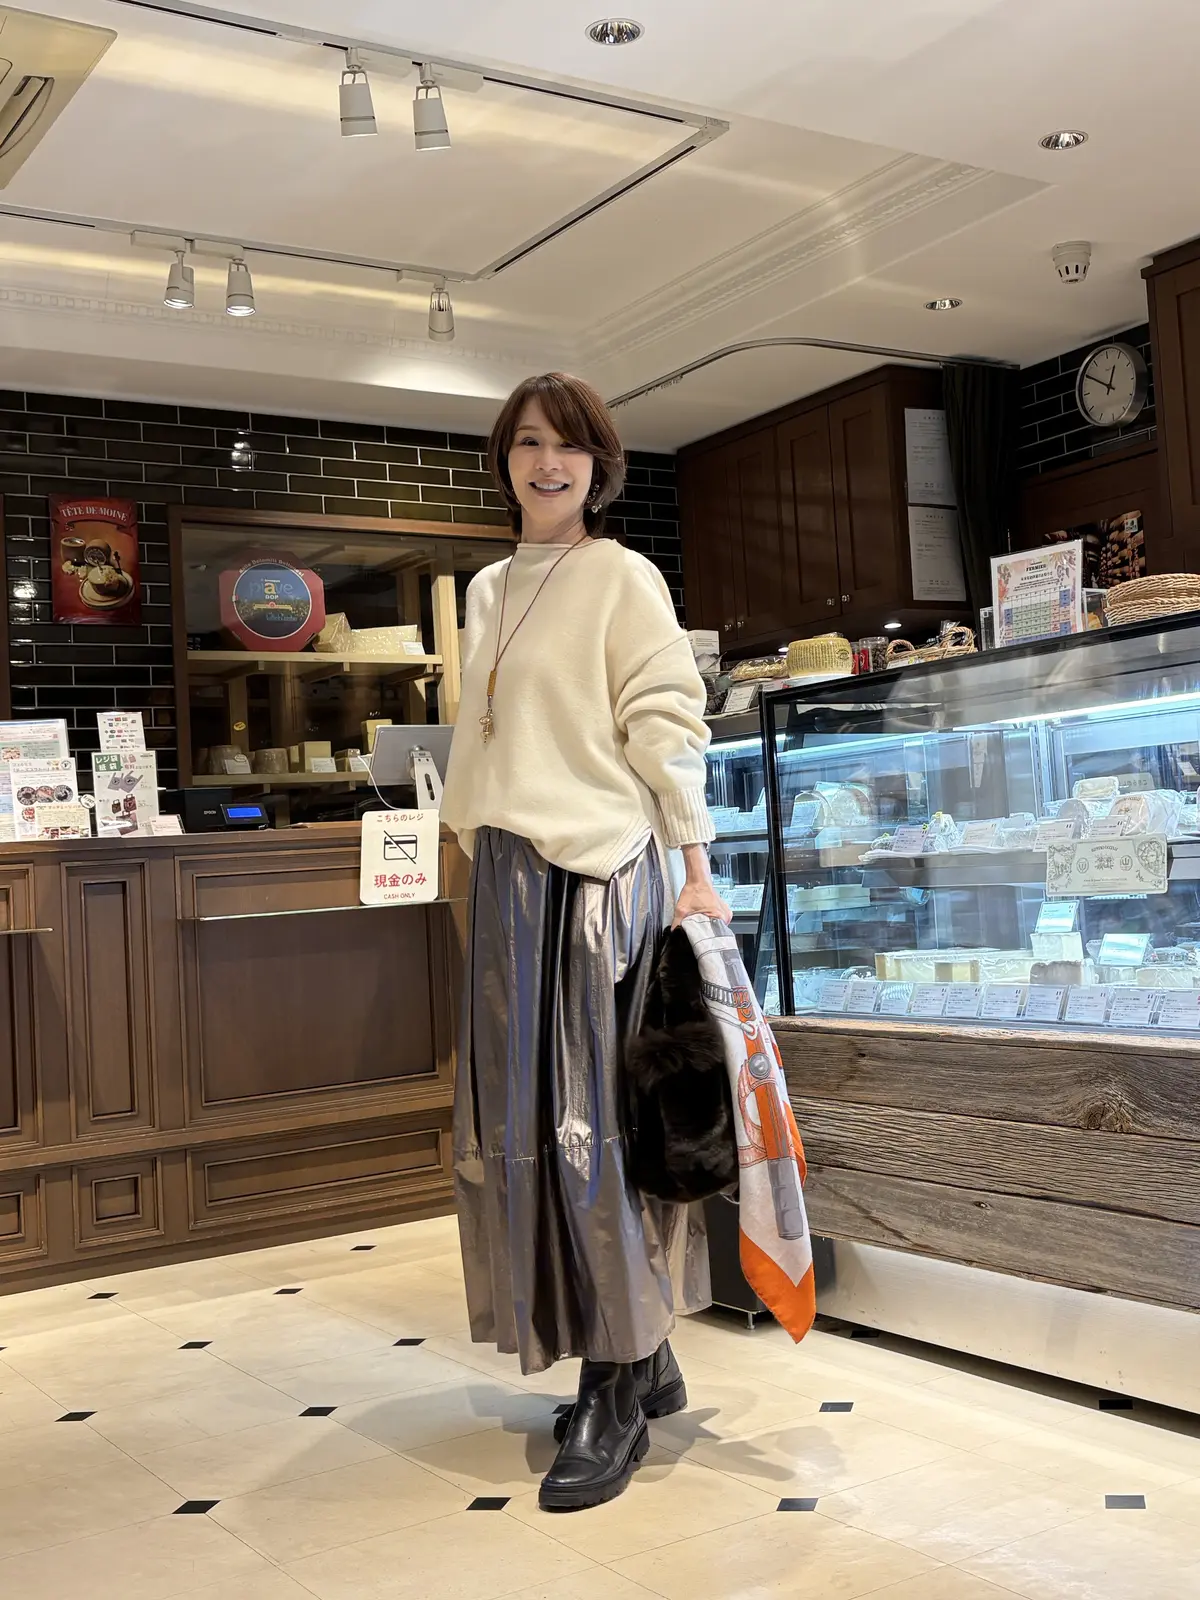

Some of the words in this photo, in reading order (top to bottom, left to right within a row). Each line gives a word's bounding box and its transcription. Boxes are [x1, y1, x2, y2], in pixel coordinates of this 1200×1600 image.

[61, 506, 85, 517] TÊTE
[85, 506, 98, 514] DE
[99, 507, 128, 521] MOINE
[95, 754, 119, 764] レジ袋
[376, 813, 424, 823] こちらのレジ
[374, 872, 427, 888] 現金のみ
